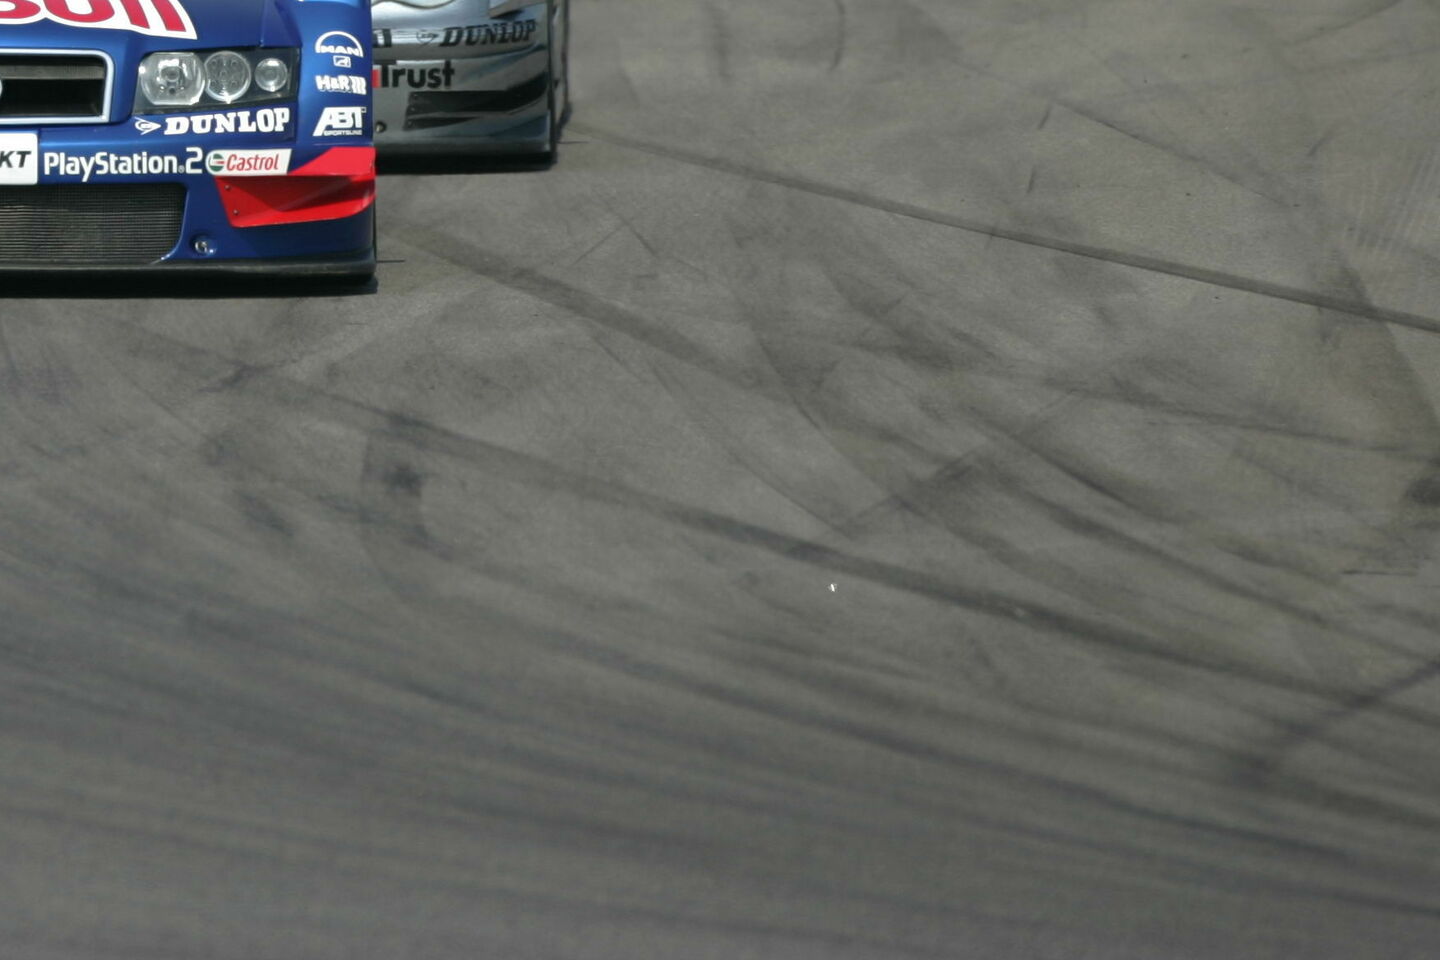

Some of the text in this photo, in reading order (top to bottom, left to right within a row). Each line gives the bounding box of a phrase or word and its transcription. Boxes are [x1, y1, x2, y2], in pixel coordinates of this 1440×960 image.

[439, 19, 537, 48] DUNLOP
[320, 45, 361, 57] MAN
[373, 60, 455, 88] Trust
[164, 107, 291, 135] DUNLOP
[313, 107, 363, 136] ABT
[226, 153, 280, 171] Castrol
